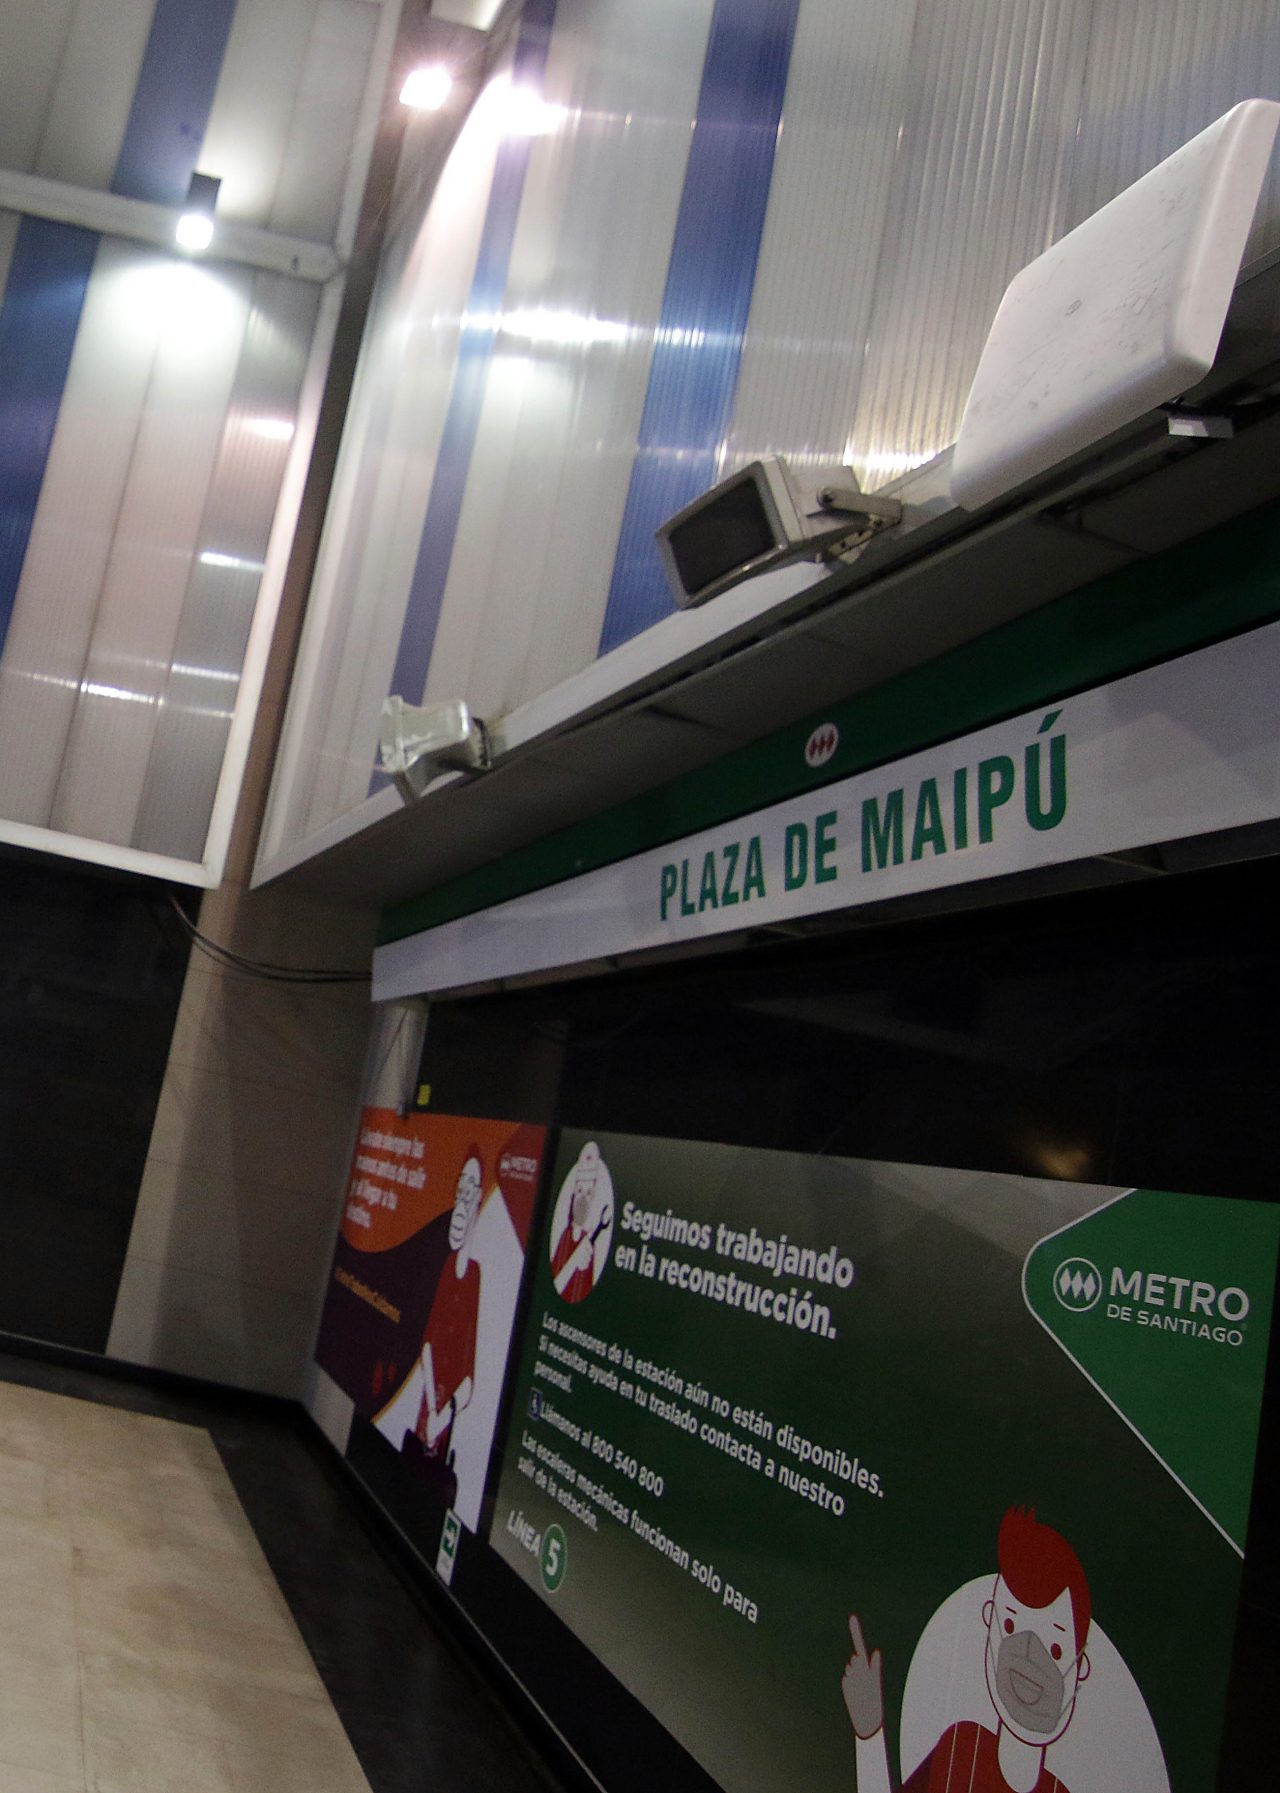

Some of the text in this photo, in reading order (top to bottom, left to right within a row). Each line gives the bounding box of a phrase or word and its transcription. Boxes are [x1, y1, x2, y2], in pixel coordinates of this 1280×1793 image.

[660, 708, 1067, 921] PLAZA DE MAIPÚ
[614, 1243, 837, 1340] en la reconstrucción.
[620, 1201, 855, 1289] Seguimos trabajando
[1107, 1303, 1243, 1346] DE SANTIAGO
[1110, 1266, 1250, 1321] METRO
[538, 1334, 846, 1517] Si necesitas ayuda en tu traslado contacta a nuestro
[540, 1401, 664, 1497] Llámanos al 800 540 800
[542, 1311, 885, 1498] Los ascensores de la estación aún no están disponibles.
[506, 1509, 561, 1577] LÍNEA 5
[522, 1429, 759, 1624] Las escaleras mecánicas funcionan solo para
[535, 1468, 547, 1490] de
[547, 1475, 558, 1497] la
[557, 1487, 599, 1532] estación.
